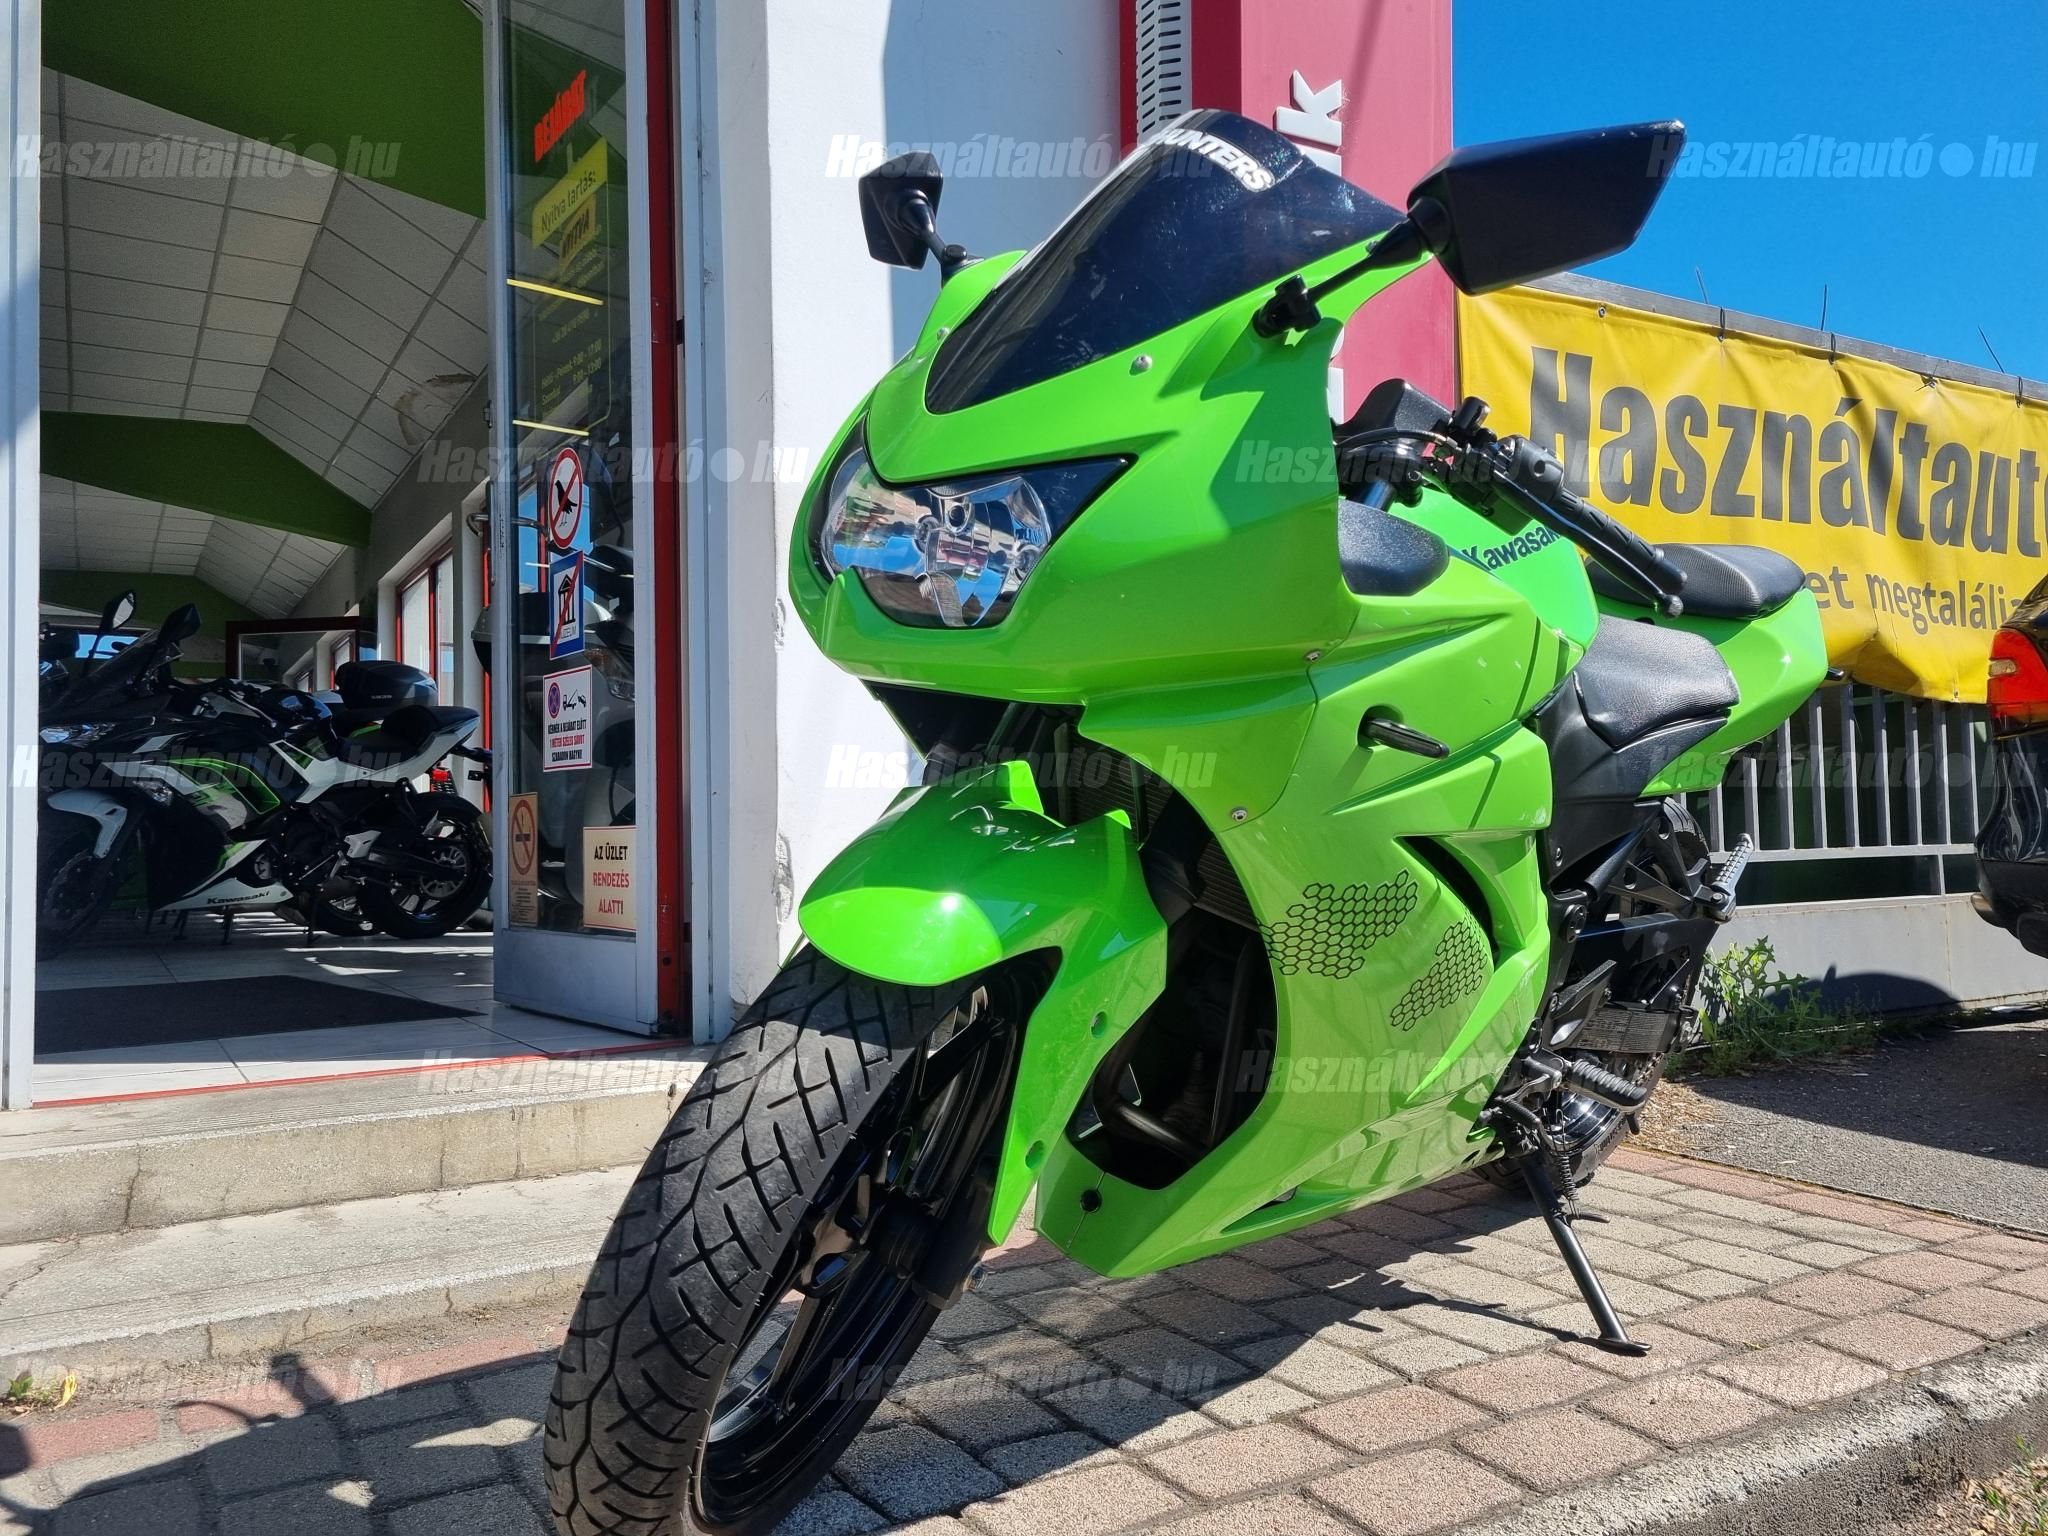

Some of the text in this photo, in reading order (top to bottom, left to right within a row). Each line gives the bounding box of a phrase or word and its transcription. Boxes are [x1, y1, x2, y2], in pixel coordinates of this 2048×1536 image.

[1529, 346, 2048, 557] Használtaut
[594, 842, 628, 860] AZ ÜZLET
[593, 869, 630, 888] RENDEZÉS
[207, 891, 270, 905] Kawasaki
